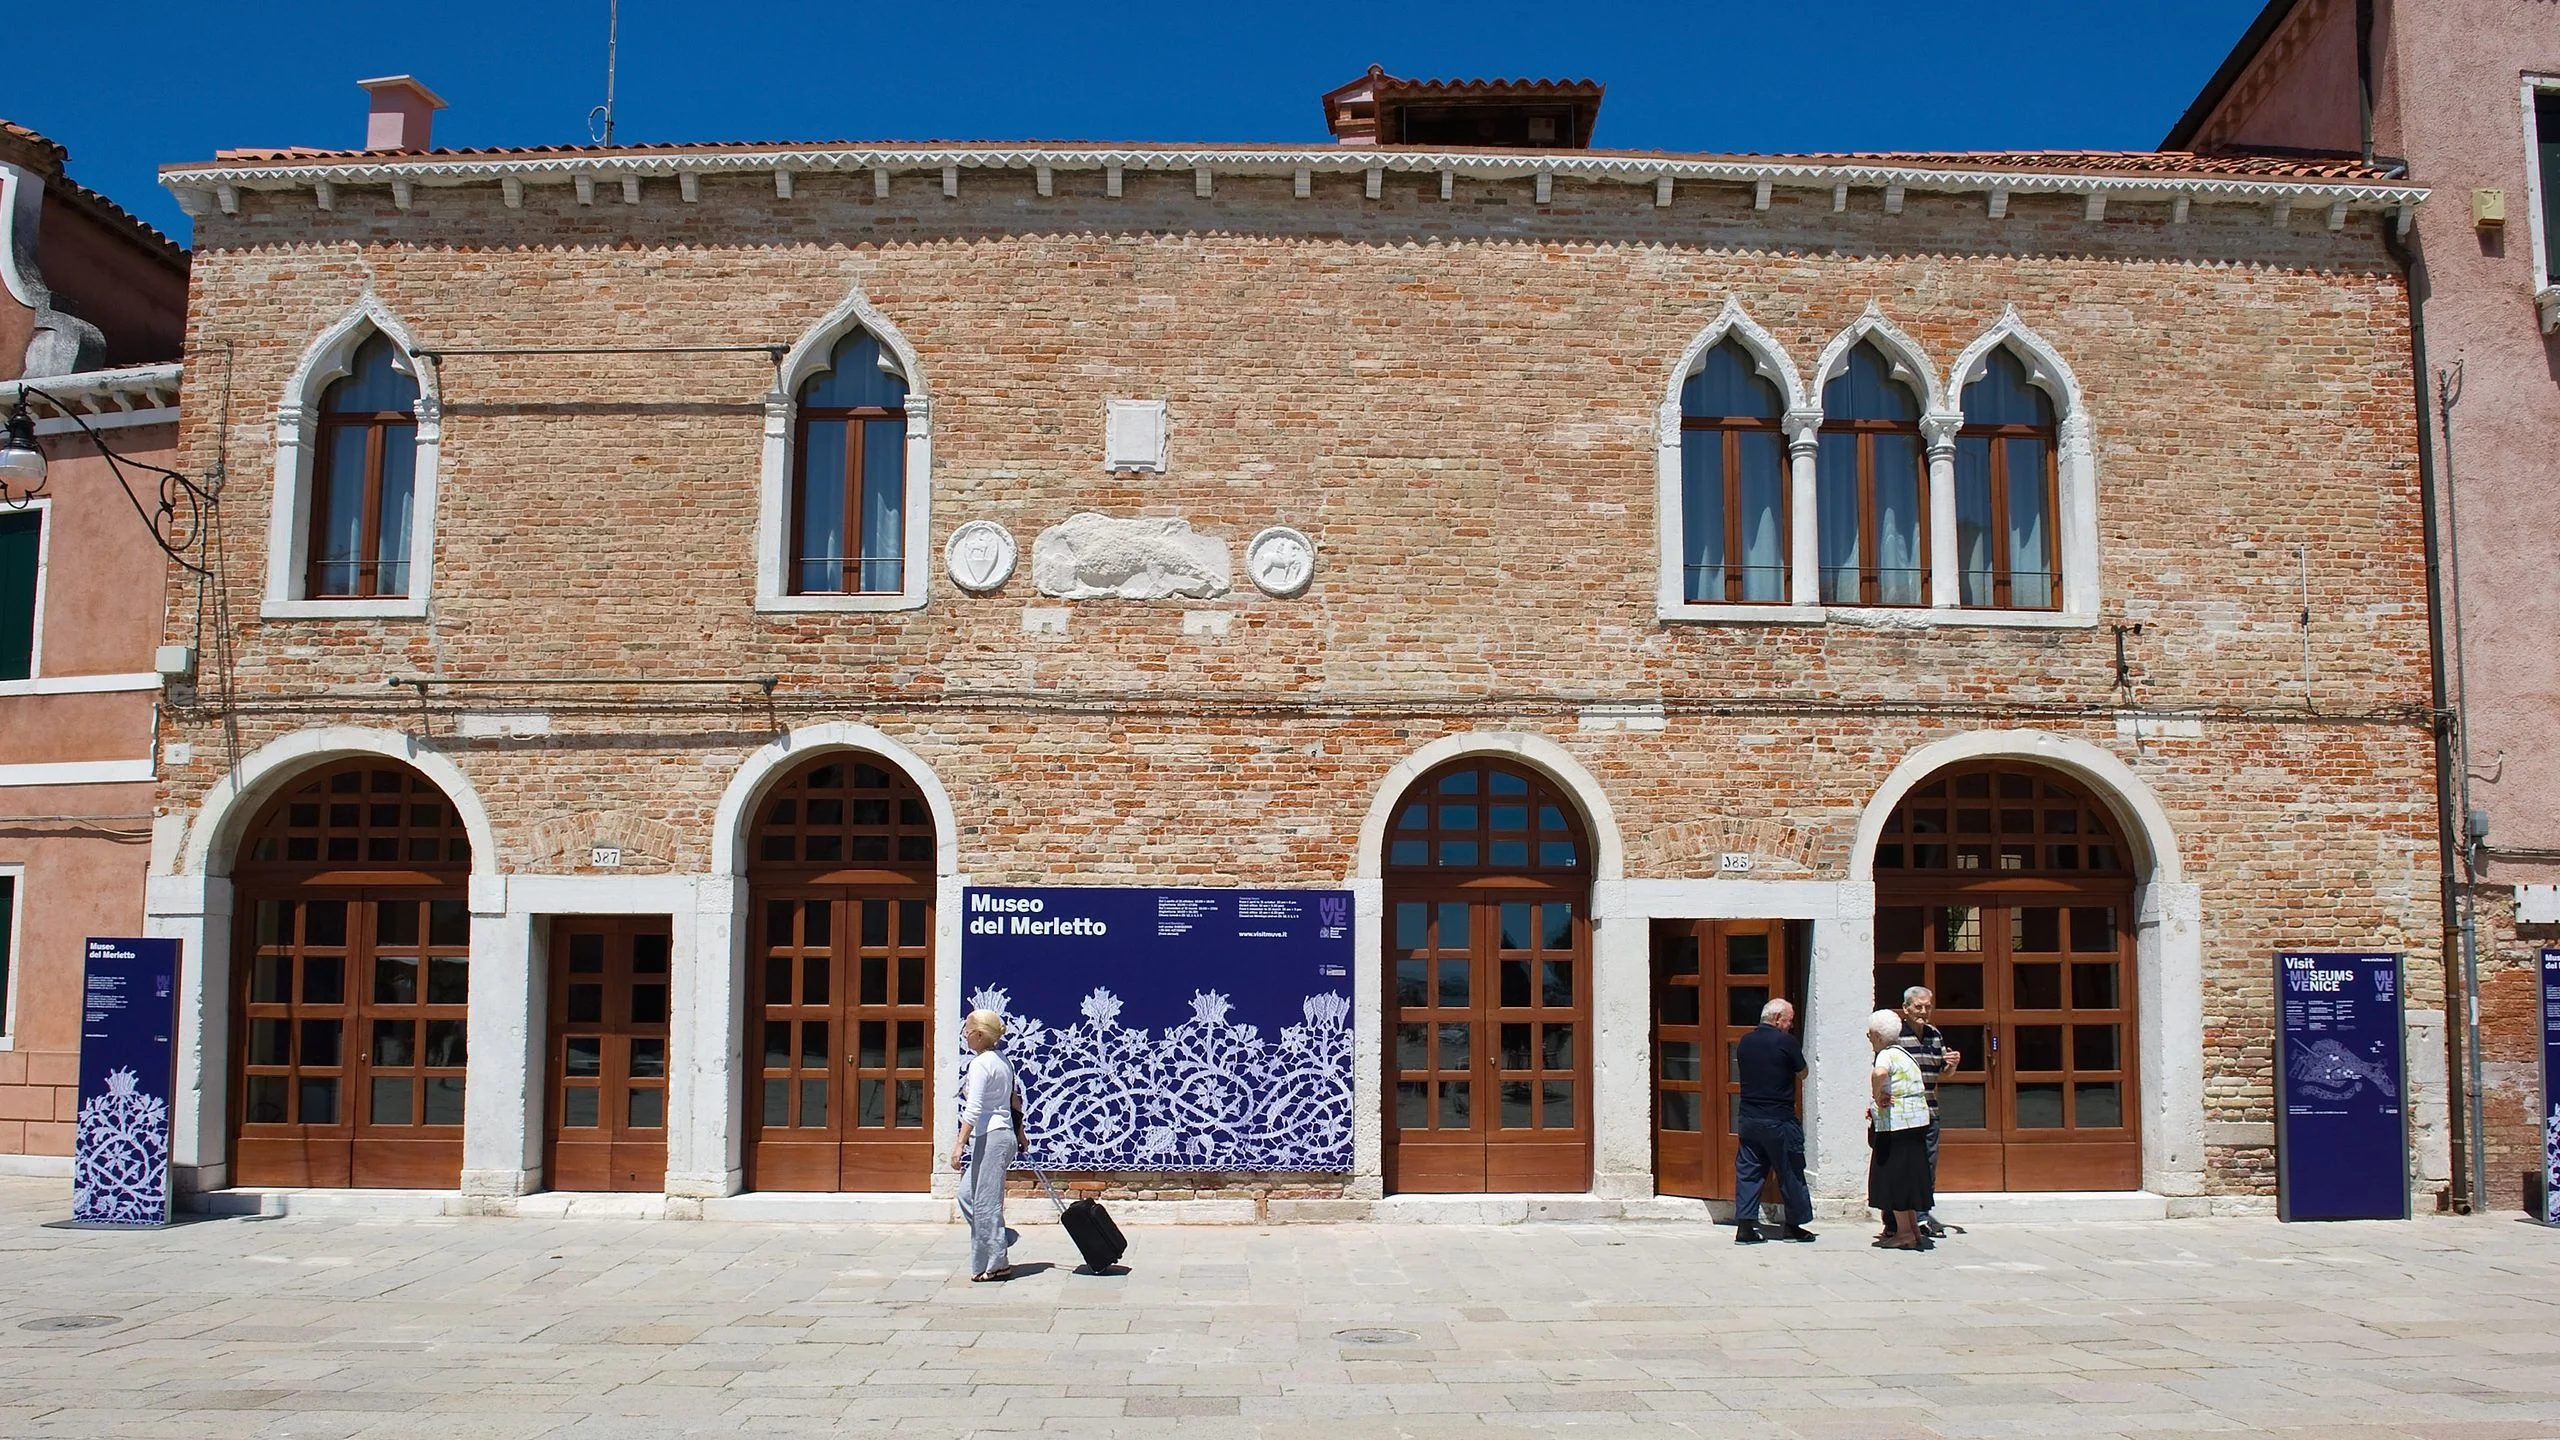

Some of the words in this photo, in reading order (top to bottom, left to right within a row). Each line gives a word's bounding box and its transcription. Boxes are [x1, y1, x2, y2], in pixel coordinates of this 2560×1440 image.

[971, 893, 1044, 913] Museo
[970, 916, 1004, 935] del
[1011, 916, 1107, 936] Merletto
[90, 942, 115, 950] Museo
[89, 951, 102, 959] del
[102, 951, 136, 959] Merletto
[2284, 957, 2315, 969] Visit
[2545, 962, 2558, 970] del
[2290, 970, 2354, 982] MUSEUMS
[2291, 981, 2341, 992] VENICE
